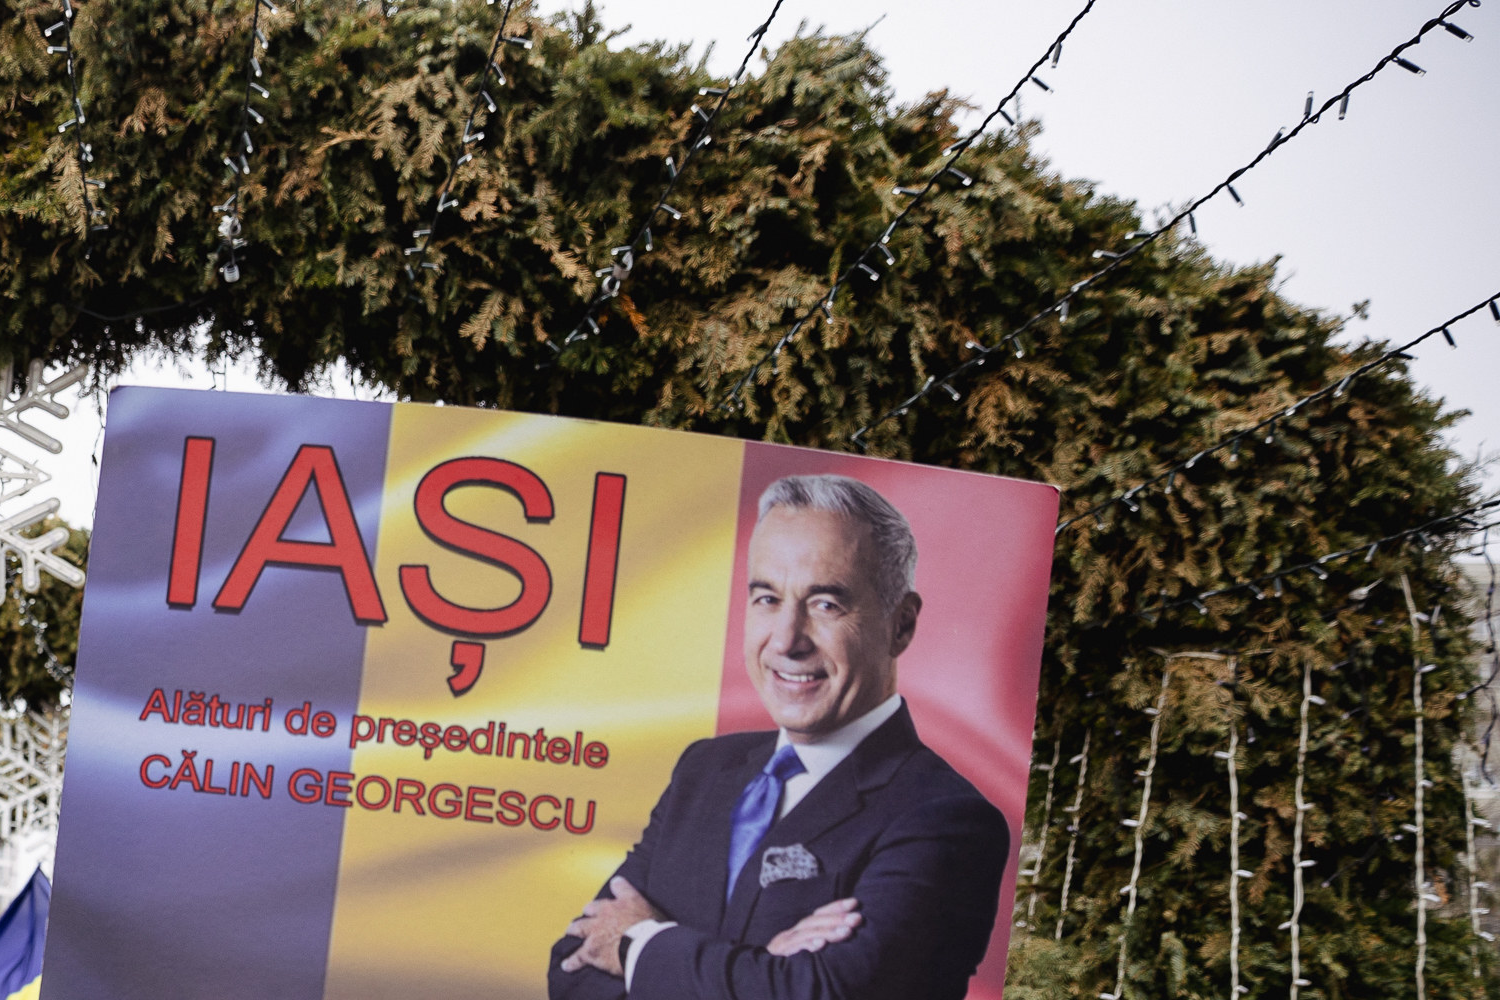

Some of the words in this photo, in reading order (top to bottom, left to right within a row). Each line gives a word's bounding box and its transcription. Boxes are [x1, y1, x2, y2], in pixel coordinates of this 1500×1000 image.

[167, 437, 627, 697] IAȘI
[139, 688, 273, 731] Alături
[284, 702, 337, 737] de
[350, 714, 609, 768] președintele
[139, 750, 274, 799] CĂLIN
[288, 768, 597, 835] GEORGESCU
